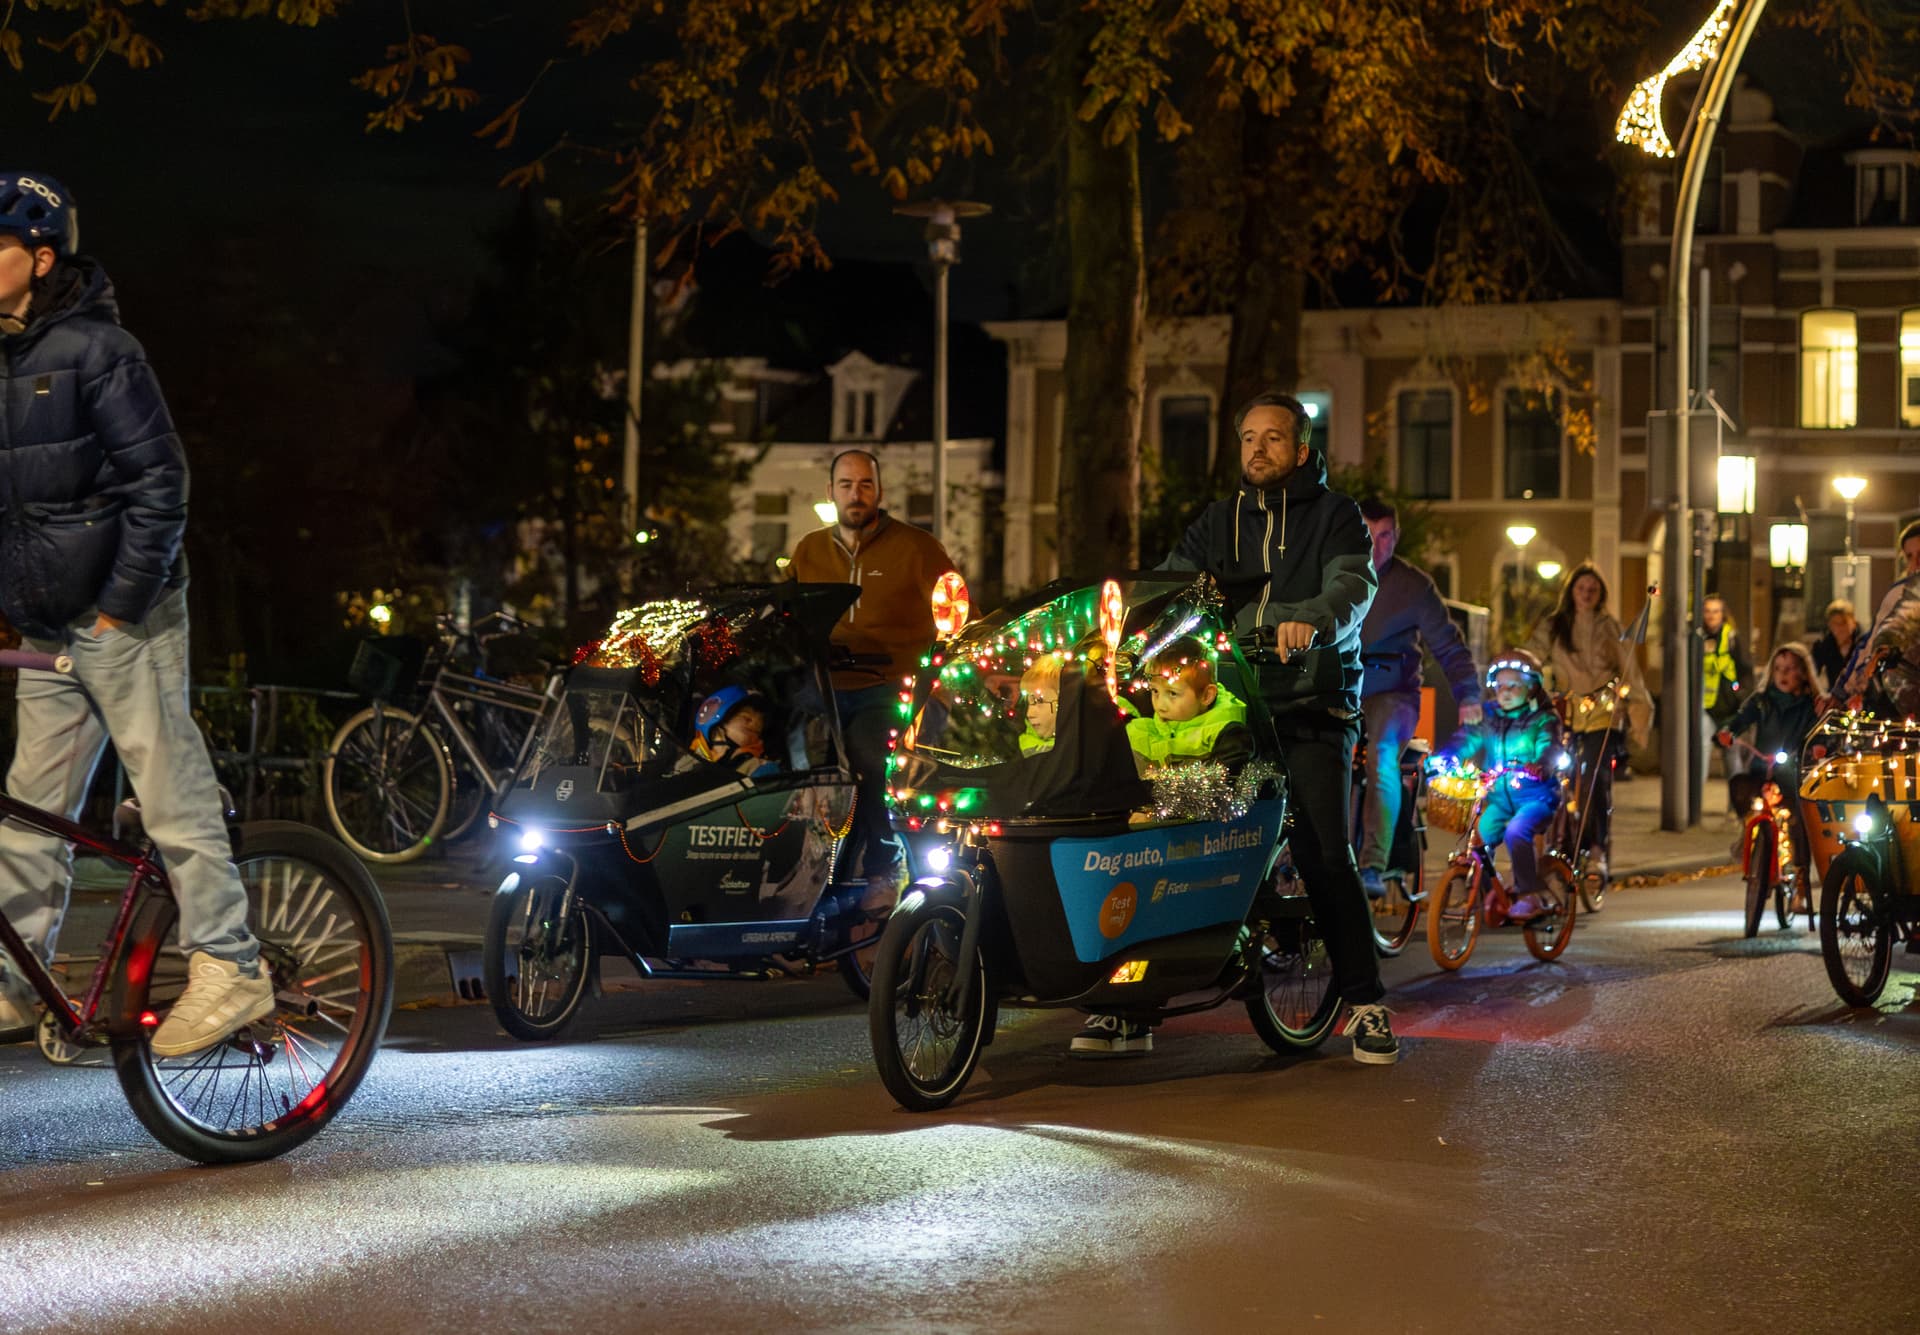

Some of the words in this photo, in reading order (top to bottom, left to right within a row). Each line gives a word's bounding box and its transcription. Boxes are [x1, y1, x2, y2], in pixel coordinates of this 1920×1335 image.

[688, 825, 766, 847] TESTFIETS
[1083, 851, 1122, 876] Dag
[1124, 848, 1164, 867] auto,
[1203, 826, 1263, 856] bakfiets!
[1111, 896, 1131, 911] Test
